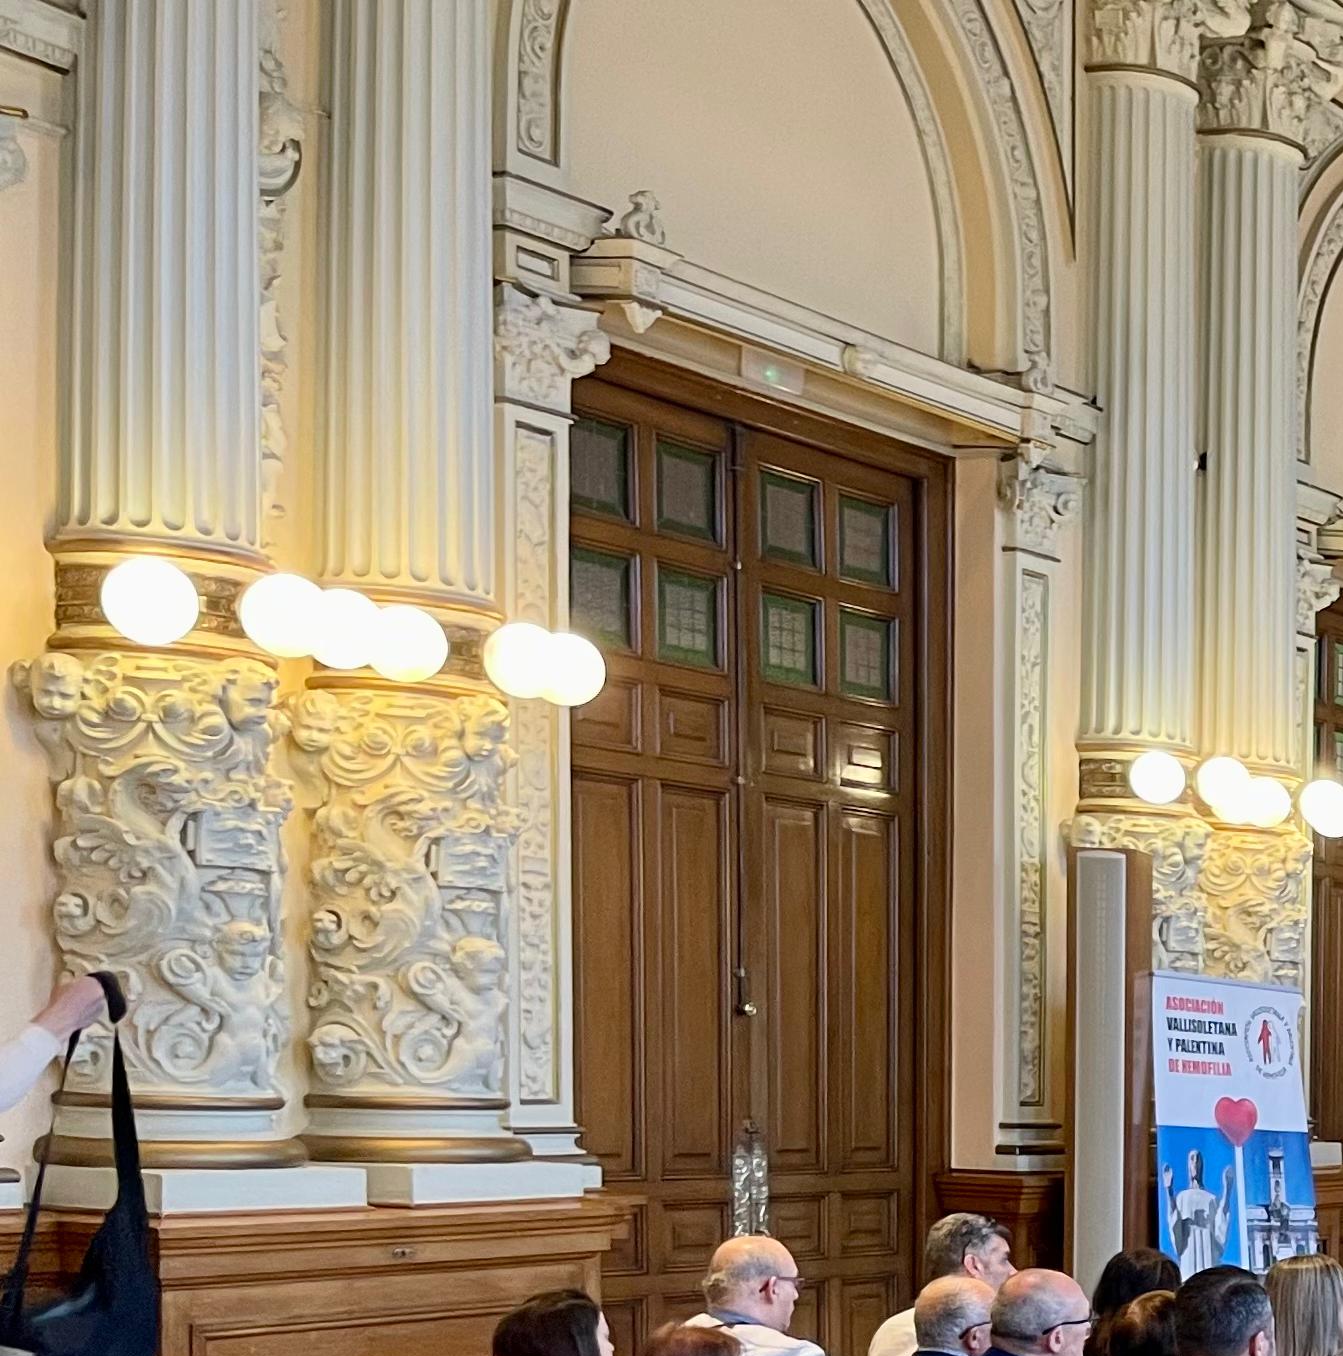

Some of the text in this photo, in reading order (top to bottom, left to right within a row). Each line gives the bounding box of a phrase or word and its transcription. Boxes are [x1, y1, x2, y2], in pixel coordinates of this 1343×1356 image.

[1166, 1016, 1238, 1037] VALLISOLETANA
[1167, 1038, 1226, 1056] Y PALENTINA
